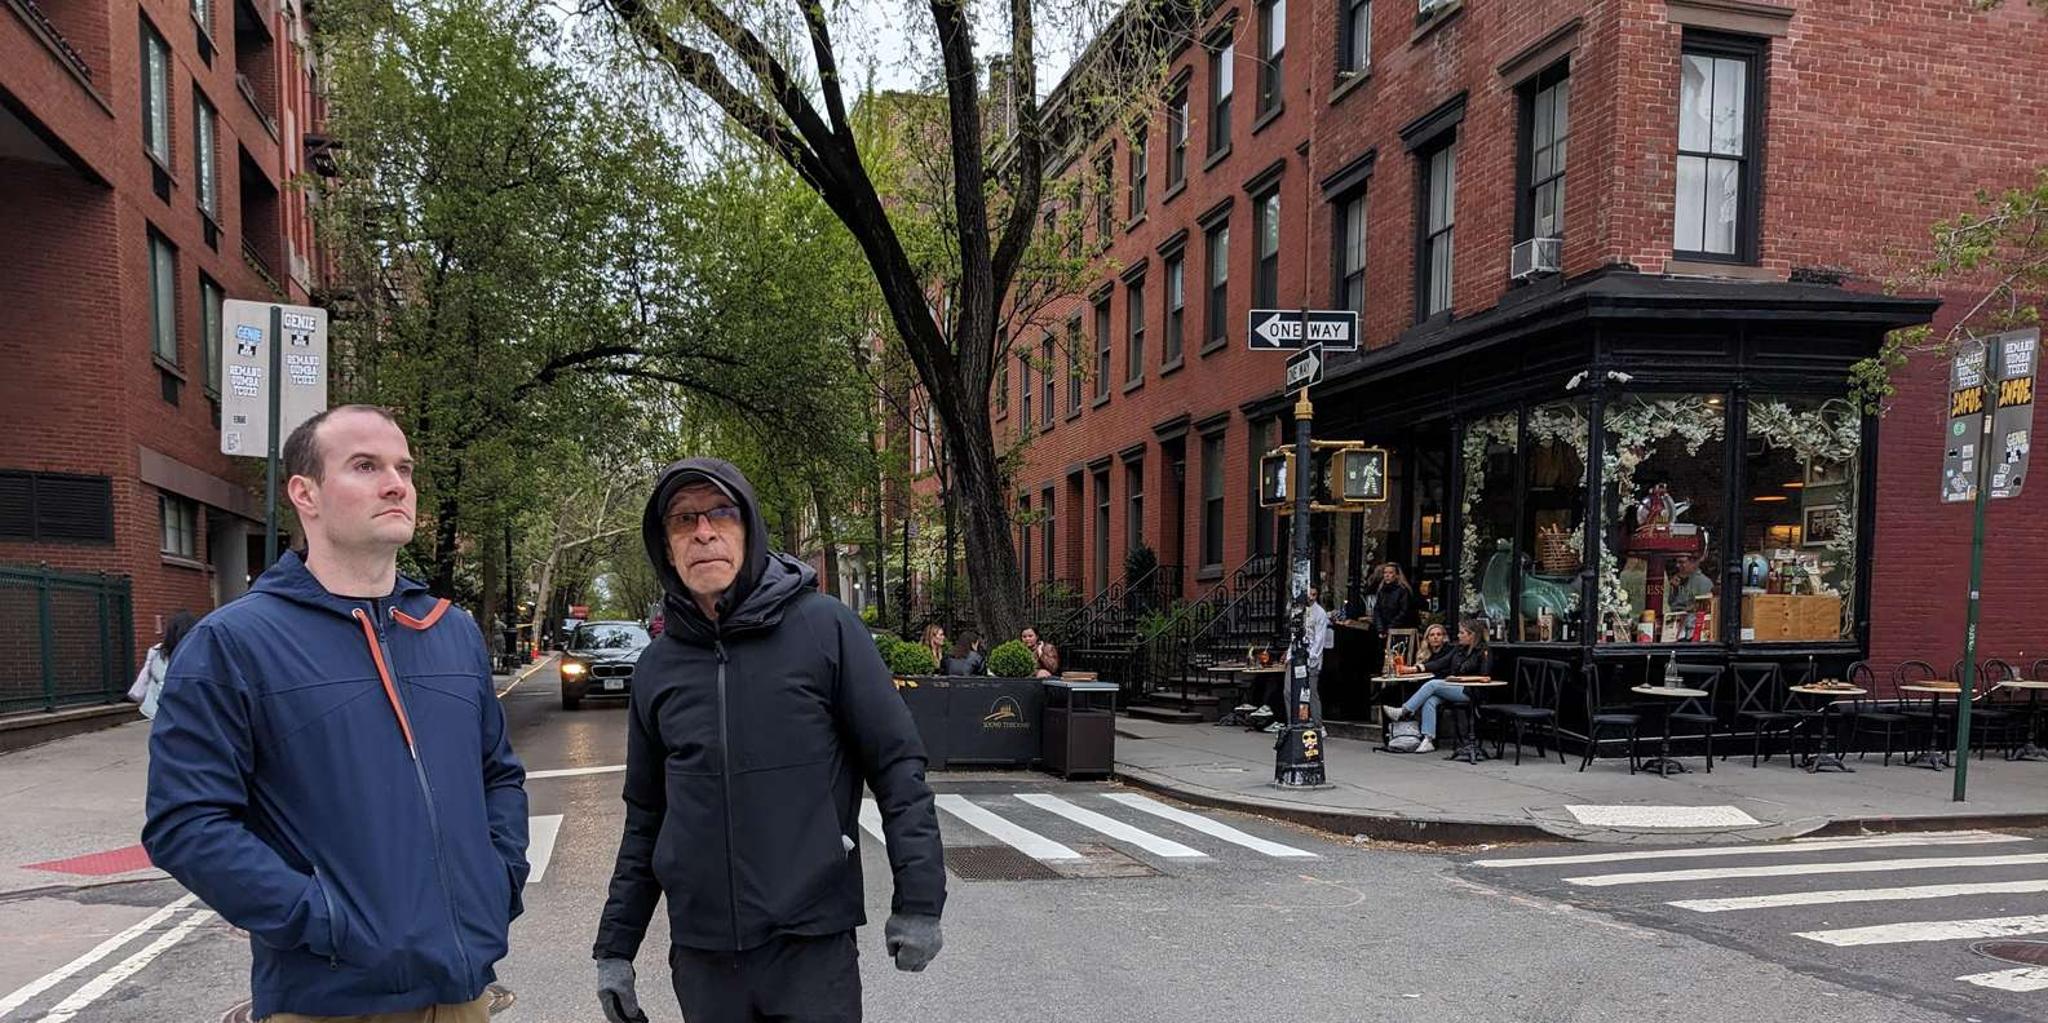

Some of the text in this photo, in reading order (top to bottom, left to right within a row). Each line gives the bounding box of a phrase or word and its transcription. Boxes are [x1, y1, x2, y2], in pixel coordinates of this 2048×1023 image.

[284, 312, 316, 331] GENIE
[1270, 323, 1342, 337] ONE WAY
[1288, 358, 1311, 380] ONE WAY
